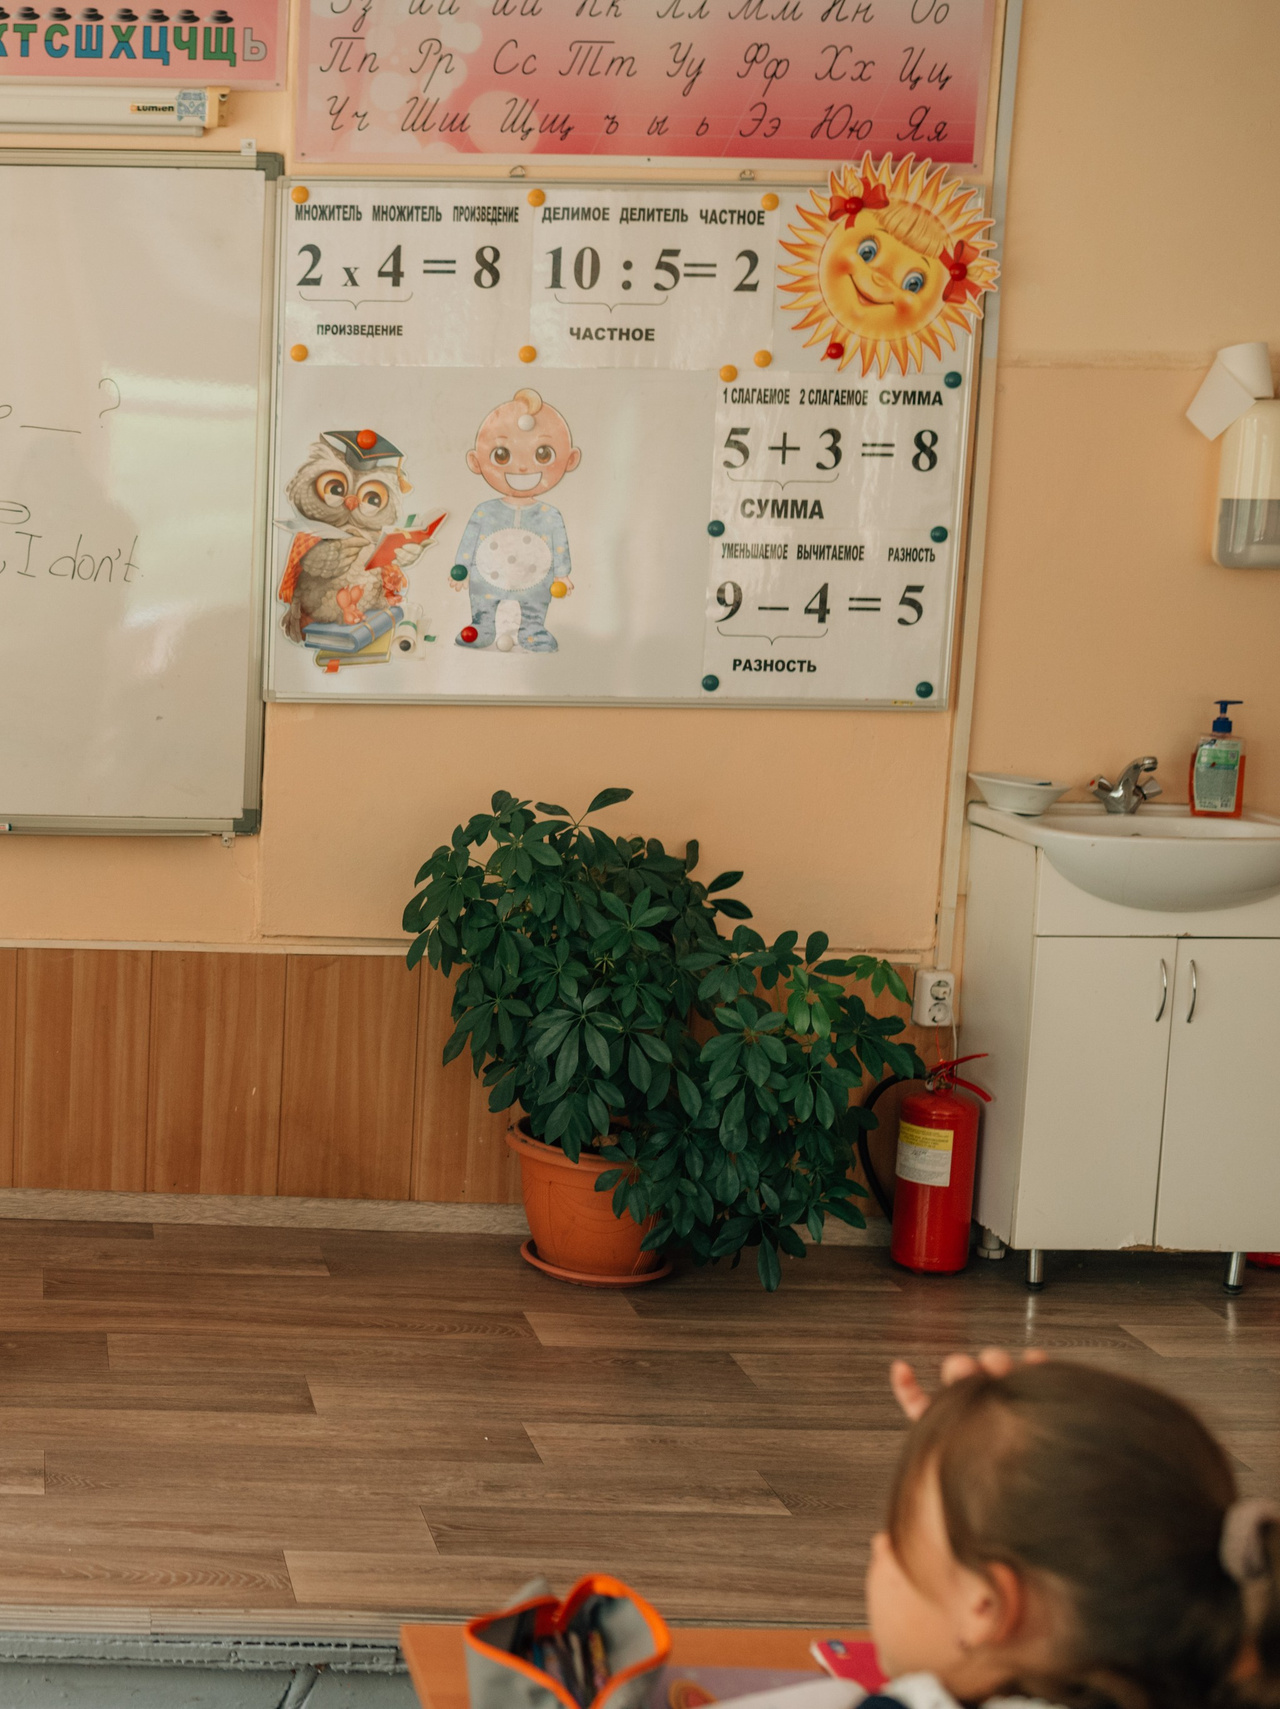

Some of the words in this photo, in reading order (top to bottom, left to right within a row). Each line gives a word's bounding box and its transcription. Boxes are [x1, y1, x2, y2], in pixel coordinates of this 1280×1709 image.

[320, 37, 379, 73] Пп
[410, 38, 455, 93] Рр
[493, 39, 537, 75] Сс
[559, 40, 637, 77] Тт
[666, 42, 706, 97] Уу
[737, 42, 790, 97] Фф
[815, 44, 875, 81] Хх
[899, 47, 953, 90] Цц
[327, 95, 370, 131] Чч
[400, 96, 471, 133] Шш
[499, 97, 575, 141] Щщ
[604, 113, 620, 135] ъ
[647, 115, 670, 136] ы
[695, 116, 710, 137] ь
[739, 101, 782, 138] Ээ
[810, 103, 873, 140] Юю
[896, 105, 948, 142] Яя
[295, 204, 363, 222] МНОЖИТЕЛЬ
[372, 205, 442, 222] МНОЖИТЕЛЬ
[452, 206, 519, 225] ПРОИЗВЕДЕНИЕ
[541, 207, 610, 223] ДЕЛИМОЕ
[620, 208, 689, 224] ДЕЛИТЕЛЬ
[700, 209, 766, 226] ЧАСТНОЕ
[296, 243, 323, 286] 2
[377, 244, 404, 287] 4
[473, 245, 501, 289] 8
[545, 246, 601, 290] 10
[733, 249, 760, 292] 2
[316, 324, 404, 338] ПРОИЗВЕДЕНИЕ
[569, 327, 655, 342] ЧАСТНОЕ
[723, 390, 728, 405] 1
[731, 388, 790, 405] СЛАГАЕМОЕ
[799, 390, 806, 405] 2
[808, 389, 869, 406] СЛАГАЕМОЕ
[879, 390, 944, 406] СУММА
[722, 427, 750, 469] 5
[816, 428, 843, 470] 3
[912, 429, 938, 472] 8
[740, 498, 824, 520] СУММА
[15, 531, 42, 578] I
[721, 542, 788, 560] УМЕНЬШАЕМОЕ
[797, 544, 865, 561] ВЫЧИТАЕМОЕ
[888, 547, 936, 563] РАЗНОСТЬ
[715, 581, 743, 623] 9
[804, 583, 830, 624] 4
[897, 585, 925, 626] 5
[732, 658, 817, 673] РАЗНОСТЬ
